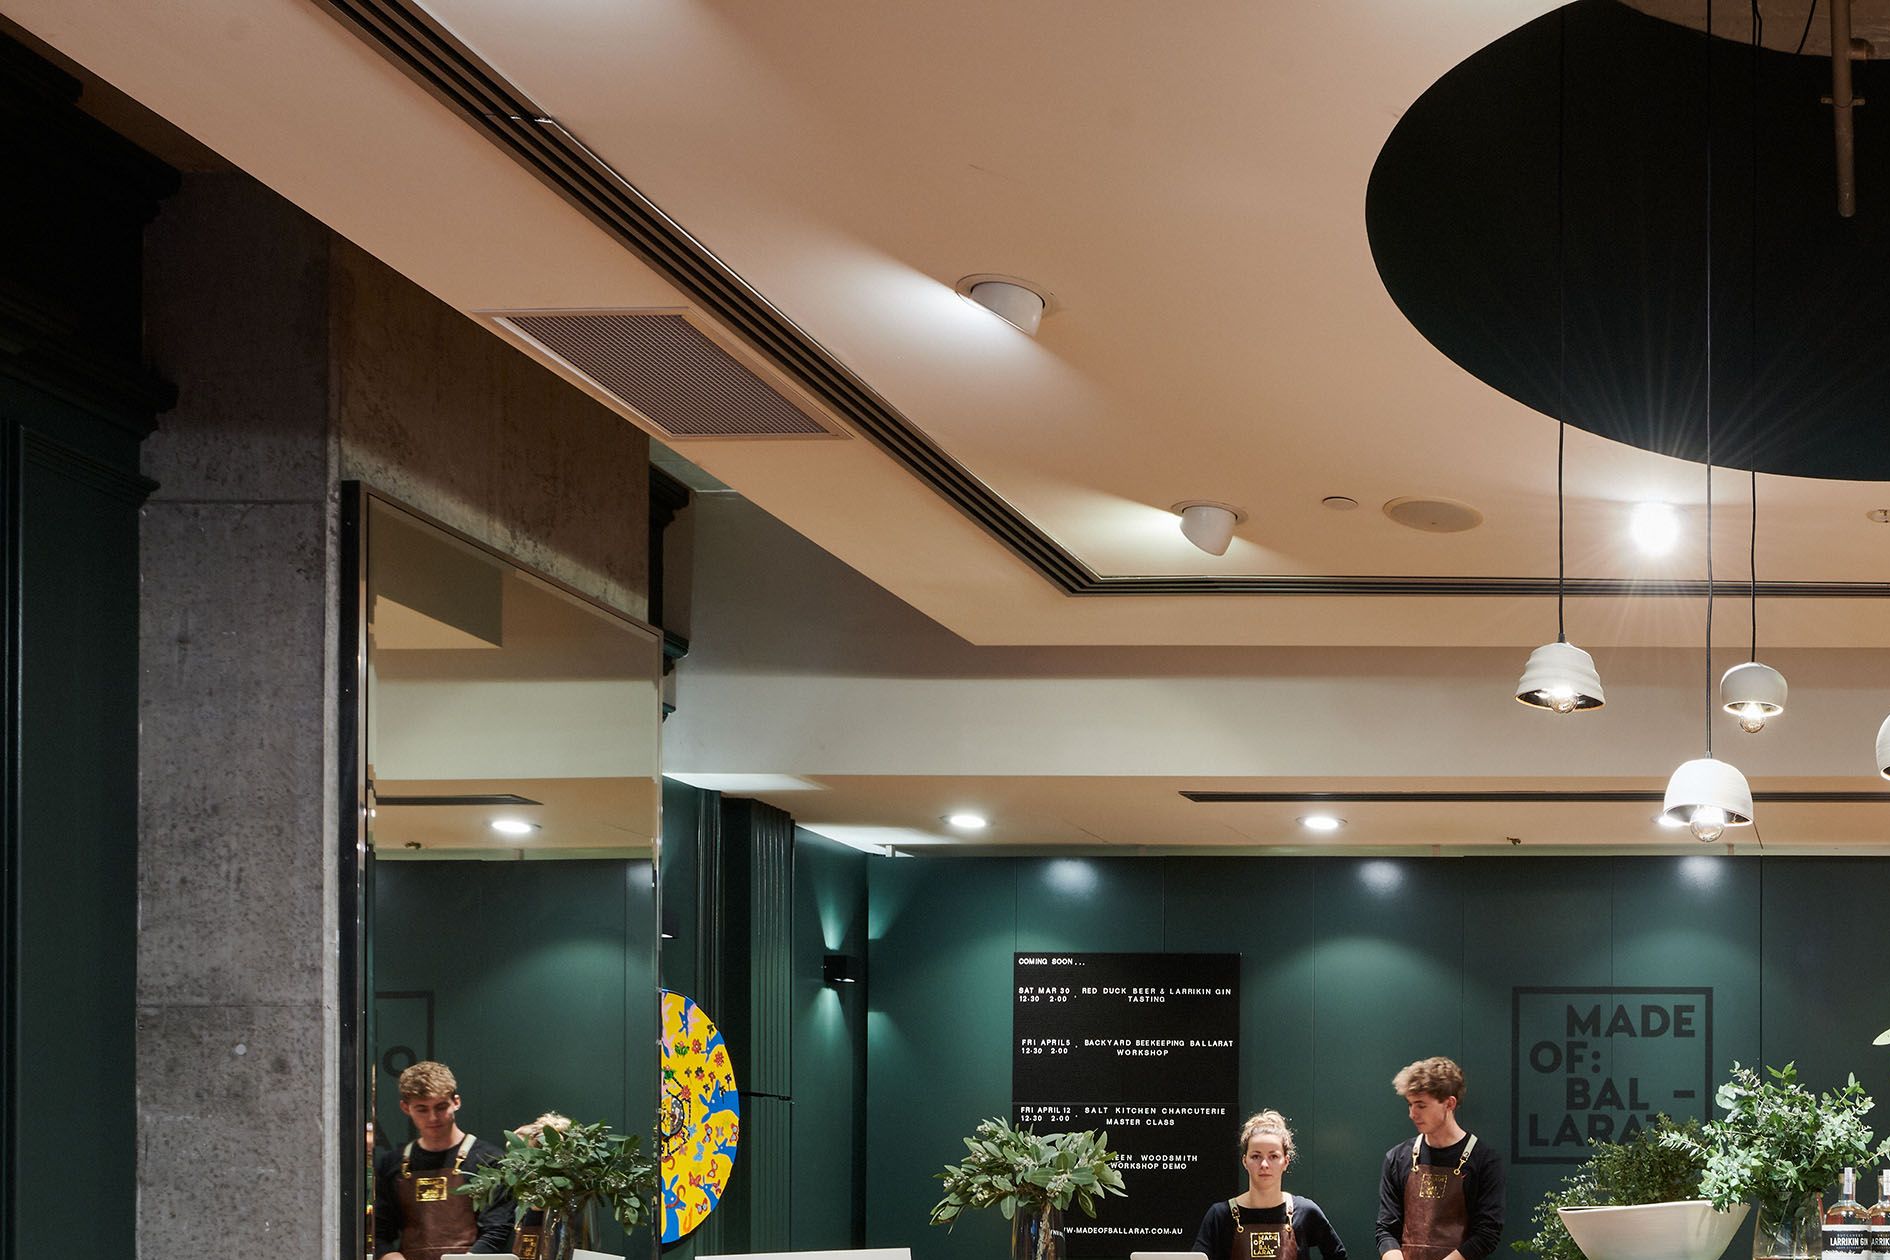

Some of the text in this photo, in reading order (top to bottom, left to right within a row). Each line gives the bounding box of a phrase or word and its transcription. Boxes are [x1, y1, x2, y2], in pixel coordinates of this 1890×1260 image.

[1018, 957, 1048, 966] COMING
[1082, 987, 1098, 995] RED
[1103, 987, 1127, 995] DUCK
[1133, 987, 1156, 995] BEER
[1215, 988, 1232, 996] GIN
[1128, 995, 1166, 1003] TASTING
[1566, 1004, 1695, 1038] MADE
[1084, 1039, 1131, 1047] BACKYARD
[1136, 1039, 1185, 1047] BEEKEEPING
[1529, 1040, 1601, 1074] OF:
[1566, 1078, 1649, 1111] BAL
[1020, 1106, 1071, 1114] FRI APRIL 12
[1162, 1107, 1226, 1115] CHARCUTERIE
[1106, 1118, 1175, 1126] MASTER CLASS
[1141, 1154, 1198, 1162] WOODSMITH
[1110, 1162, 1187, 1170] WORKSHOP DEMO
[1830, 1237, 1859, 1246] LARRIKIN
